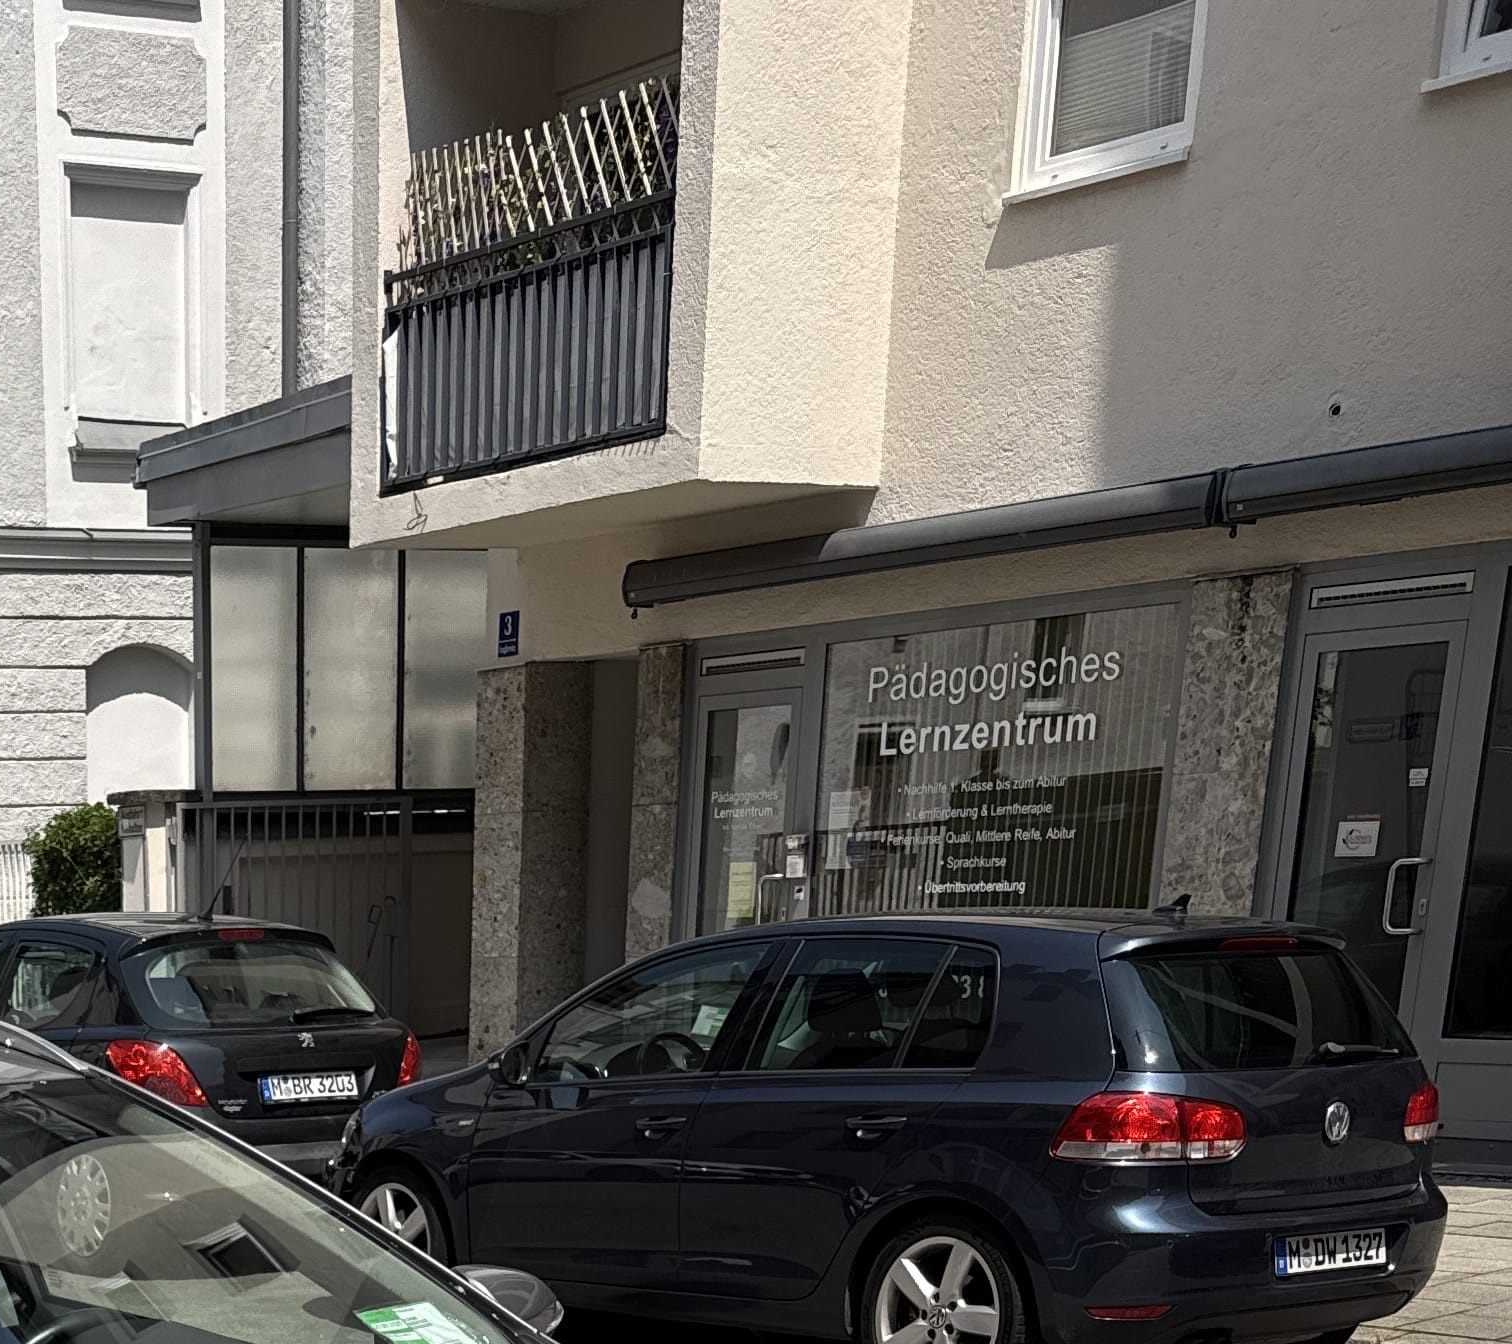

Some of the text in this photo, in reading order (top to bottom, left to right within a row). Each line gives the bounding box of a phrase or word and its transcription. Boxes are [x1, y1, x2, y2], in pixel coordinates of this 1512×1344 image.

[503, 615, 513, 636] 3
[867, 645, 1122, 706] Pädagogisches
[879, 710, 1098, 757] Lernzentrum
[903, 783, 947, 796] Nachhilfe
[960, 780, 994, 793] Klasse
[996, 778, 1011, 790] bis
[1013, 778, 1034, 789] zum
[1036, 775, 1068, 788] Abitur
[714, 806, 774, 819] Lernzentrum
[980, 806, 988, 817] &
[990, 801, 1053, 817] Lerntherapie
[975, 829, 1012, 843] Mittlere
[1045, 825, 1077, 840] Abitur
[946, 855, 1007, 871] Sprachkurse
[924, 879, 1027, 895] Übertrittsvorbereitung
[271, 1077, 283, 1097] M
[292, 1076, 314, 1096] BR
[317, 1073, 355, 1094] 3203
[1288, 1231, 1383, 1270] M DW 1327
